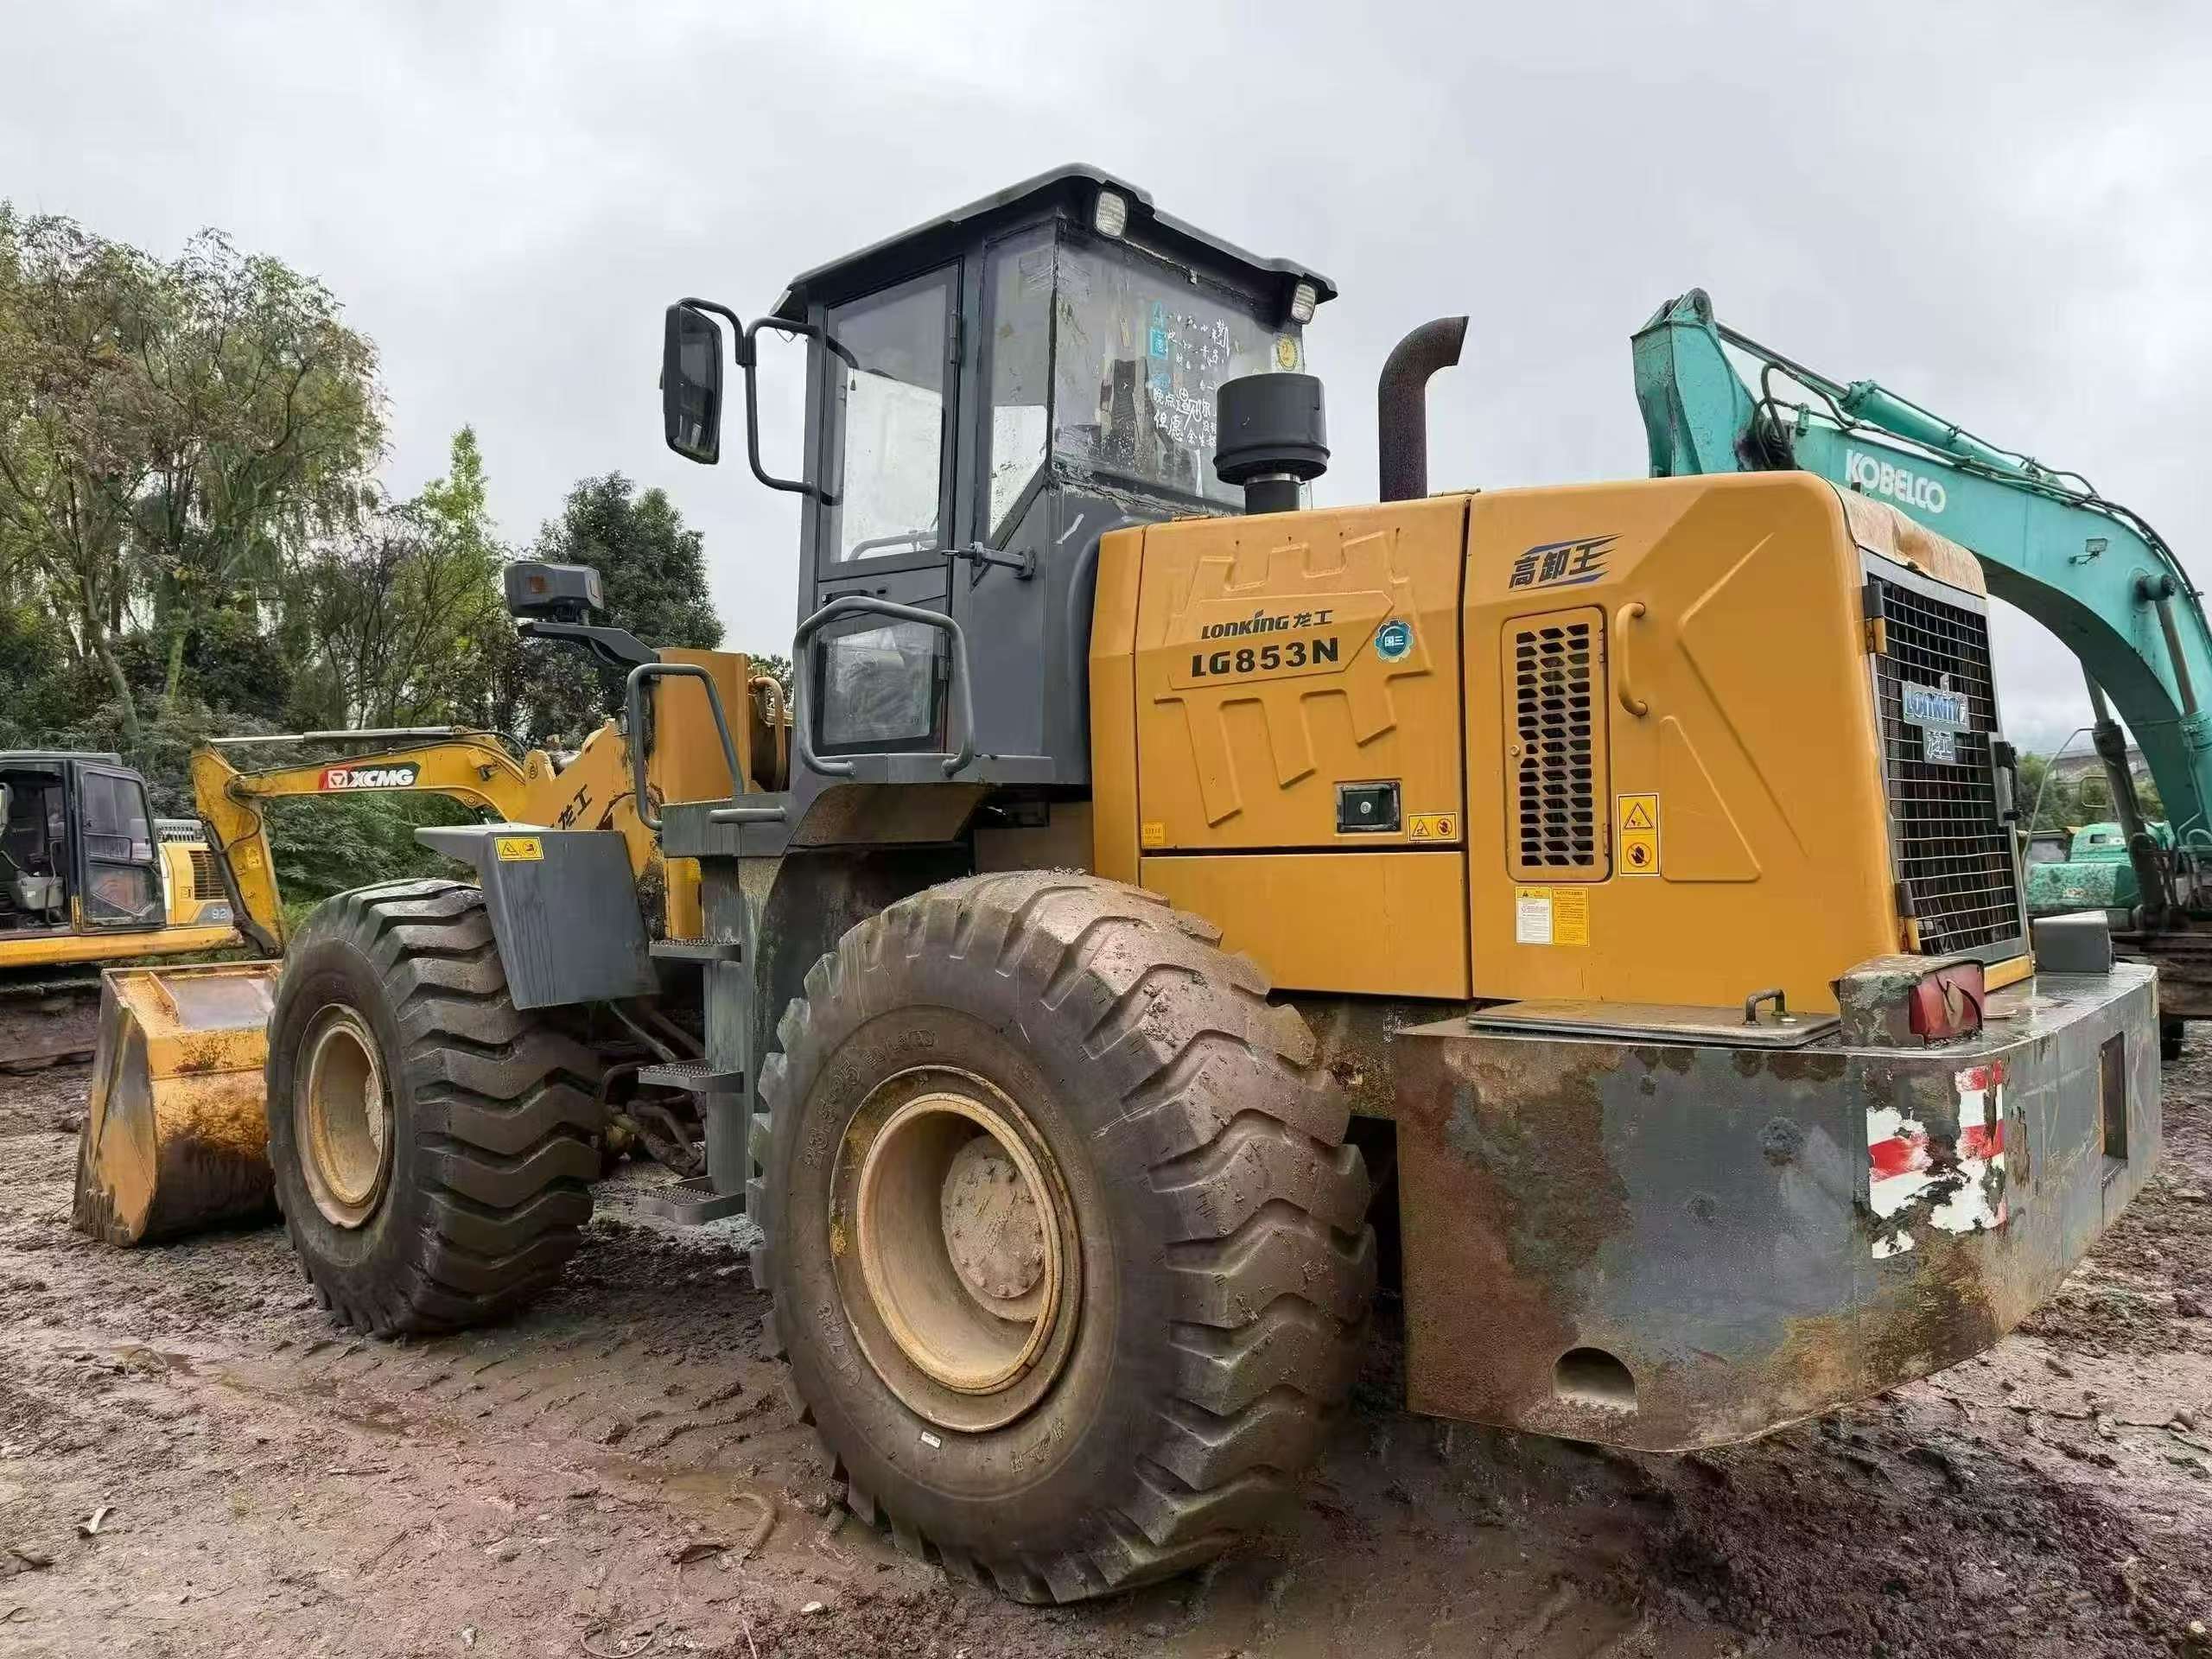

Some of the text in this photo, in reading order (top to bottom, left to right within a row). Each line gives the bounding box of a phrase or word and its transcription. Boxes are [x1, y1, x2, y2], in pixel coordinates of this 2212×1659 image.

[1846, 448, 1946, 513] KOBELCO
[1293, 609, 1334, 628] 龙工
[1192, 637, 1338, 677] LG853N
[347, 768, 415, 788] XCMG
